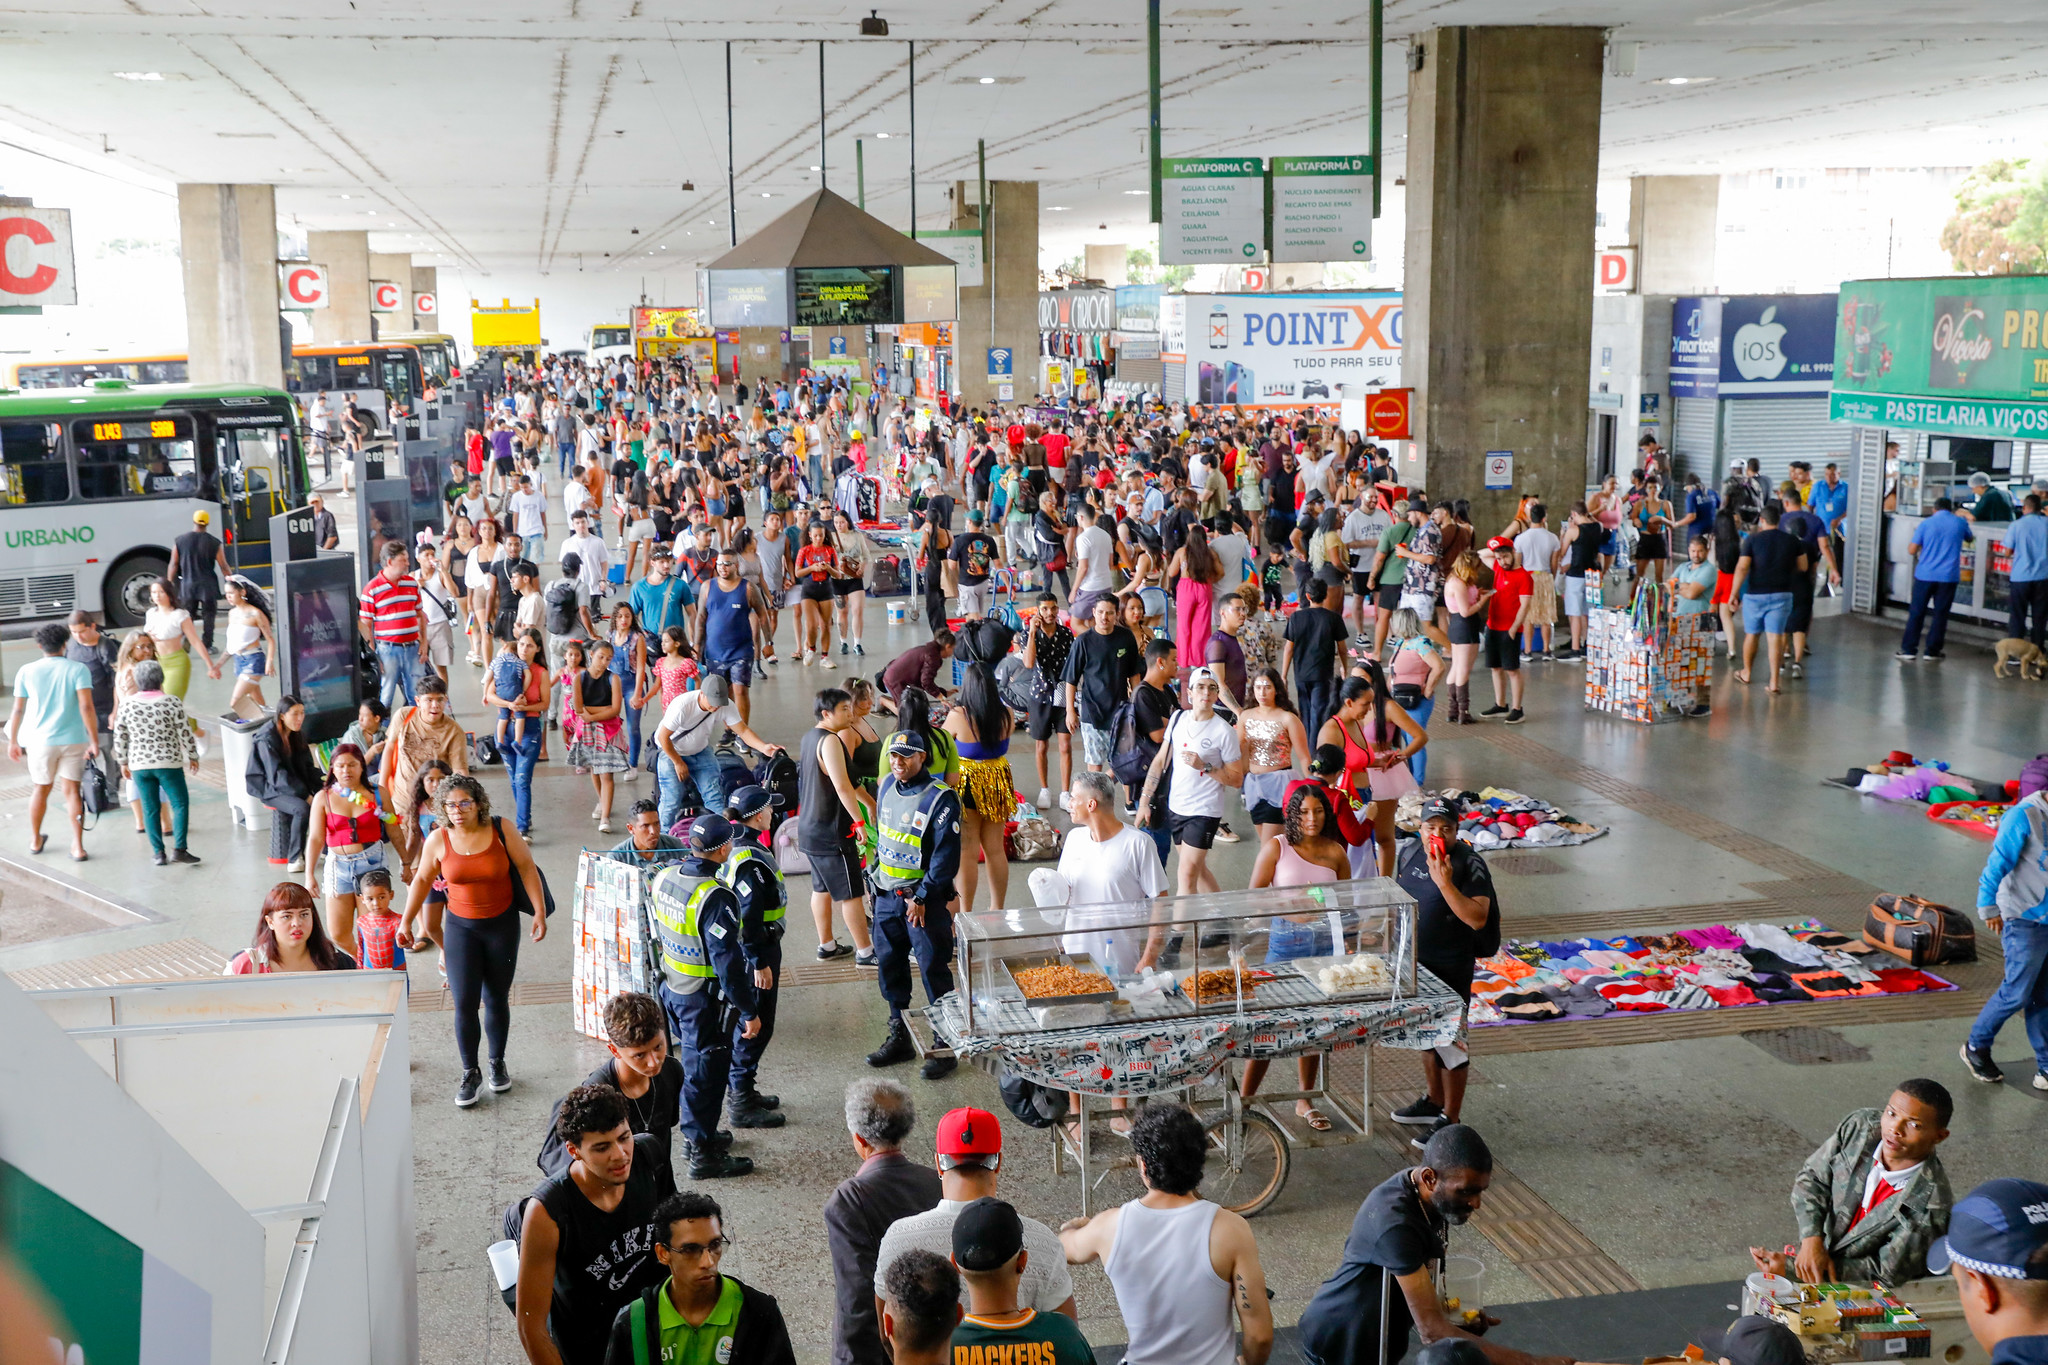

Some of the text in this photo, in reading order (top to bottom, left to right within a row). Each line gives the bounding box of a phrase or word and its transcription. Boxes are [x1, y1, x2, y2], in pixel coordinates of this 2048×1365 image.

[1174, 161, 1253, 173] PLATAFORMA C
[1284, 160, 1362, 171] PLATAFORMA D
[0, 217, 58, 295] C
[1182, 248, 1211, 256] VICENTE
[1600, 254, 1627, 285] D
[288, 268, 322, 304] C
[853, 284, 866, 292] ATÉ
[1246, 270, 1264, 291] D
[376, 285, 398, 308] C
[417, 295, 433, 312] C
[825, 292, 869, 301] PLATAFORMA
[744, 304, 752, 316] F
[839, 302, 849, 315] F
[1072, 295, 1110, 329] CARIOCA
[1933, 309, 1992, 364] Viçosa
[1742, 341, 1775, 362] iOS
[1294, 356, 1393, 369] TUDO PARA SEU
[1886, 400, 1988, 427] PASTELARIA
[405, 418, 420, 428] C 03
[365, 451, 384, 462] C 02
[288, 517, 315, 534] C 01
[5, 526, 95, 548] URBANO
[303, 619, 343, 633] ANUNCIE
[937, 806, 950, 825] APMB
[1254, 1034, 1276, 1043] BBQ
[1333, 1041, 1355, 1051] BBQ
[1129, 1061, 1152, 1071] BBQ
[954, 1341, 1057, 1365] PACKERS
